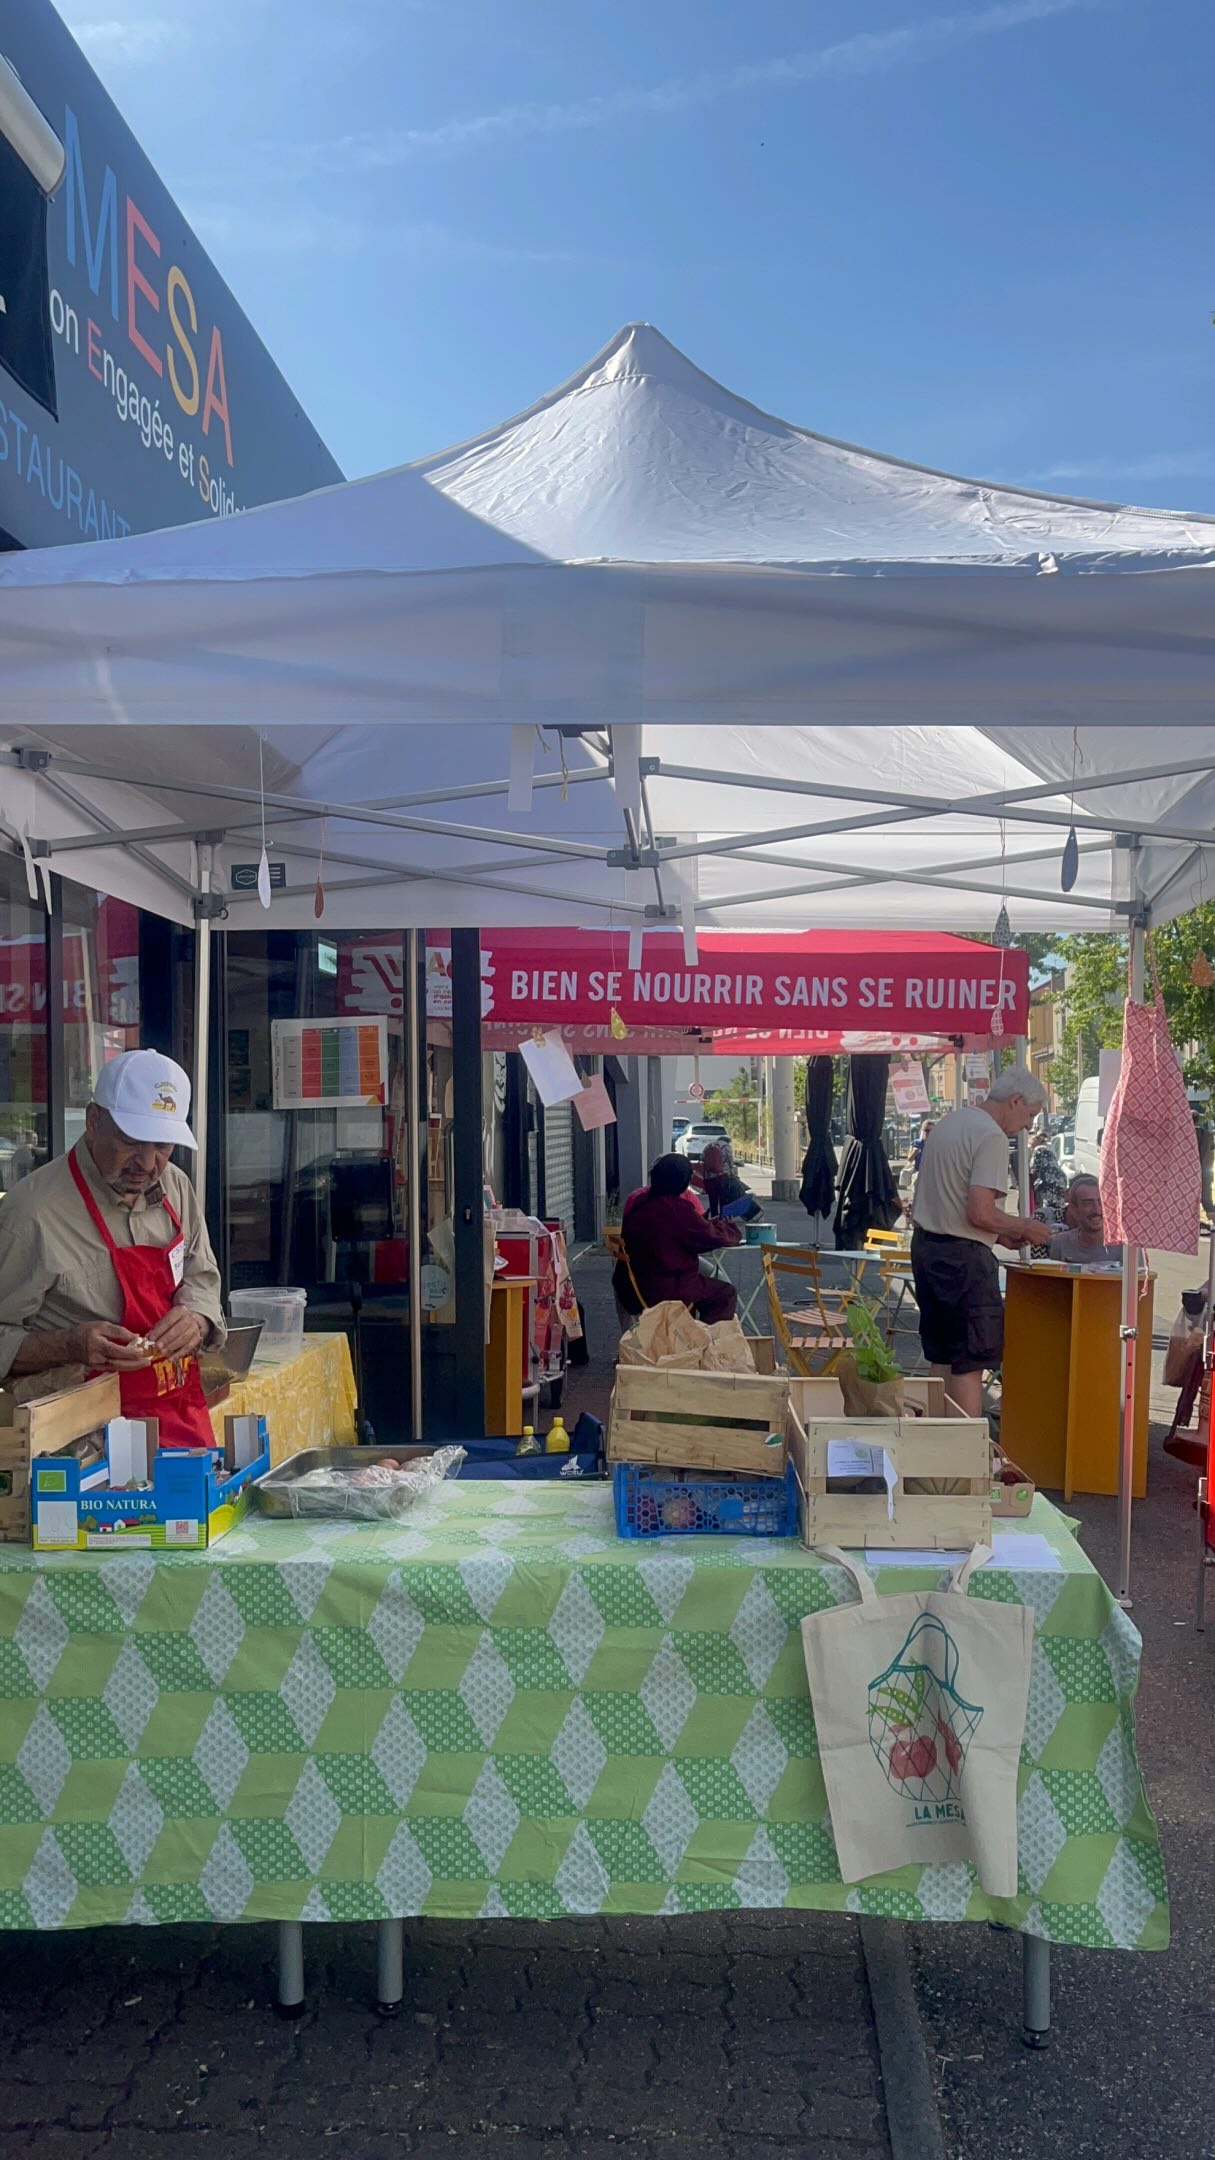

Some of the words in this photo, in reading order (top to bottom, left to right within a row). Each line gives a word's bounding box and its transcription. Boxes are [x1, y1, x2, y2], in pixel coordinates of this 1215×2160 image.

[65, 104, 234, 467] MESA
[88, 317, 173, 460] Engagée
[179, 443, 194, 487] et
[199, 454, 246, 518] Solid
[511, 970, 577, 1000] BIEN
[588, 971, 622, 1001] SE
[633, 971, 763, 1005] NOURRIR
[774, 975, 848, 1007] SANS
[859, 977, 894, 1008] SE
[905, 978, 1016, 1010] RUINER
[81, 1500, 103, 1510] BIO
[106, 1500, 157, 1510] NATURA
[914, 1806, 931, 1819] LA
